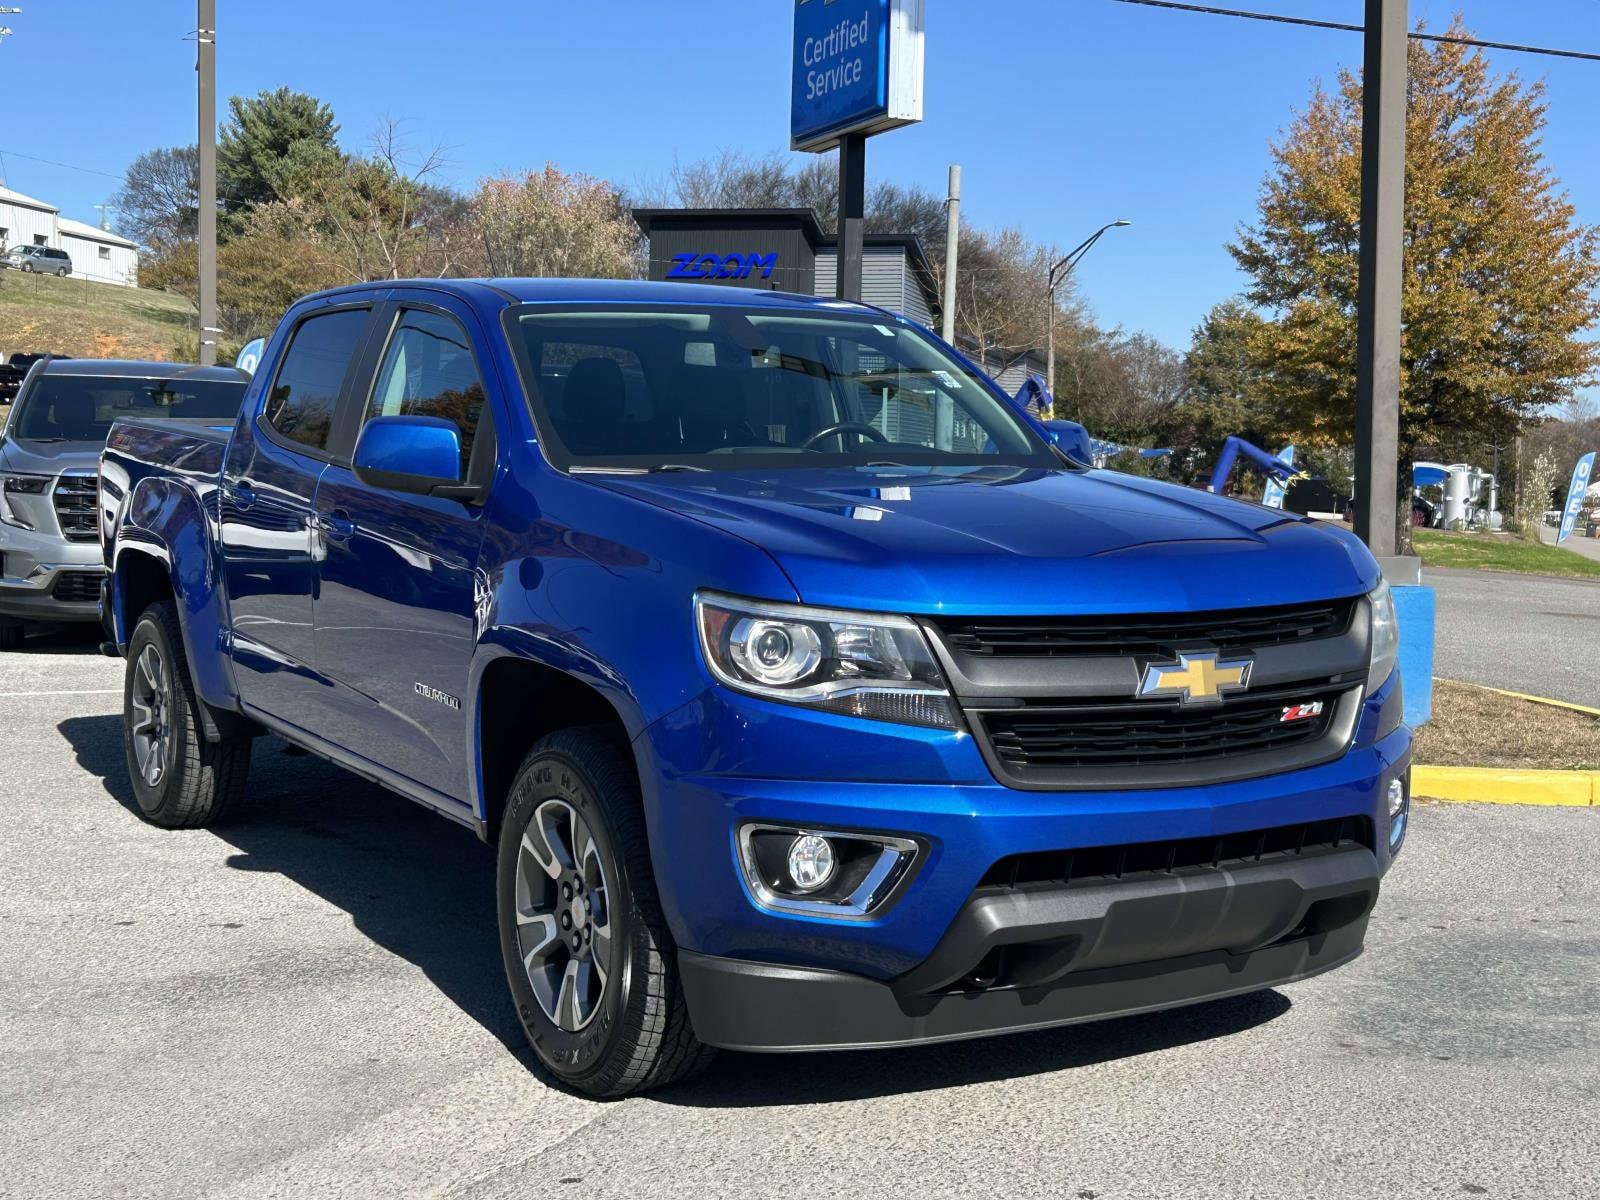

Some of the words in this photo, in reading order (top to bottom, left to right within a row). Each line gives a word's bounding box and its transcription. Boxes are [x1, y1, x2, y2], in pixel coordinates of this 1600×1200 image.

[803, 10, 868, 67] Certified
[806, 57, 862, 100] Service
[666, 252, 779, 279] ZOOM
[1280, 701, 1323, 721] Z71
